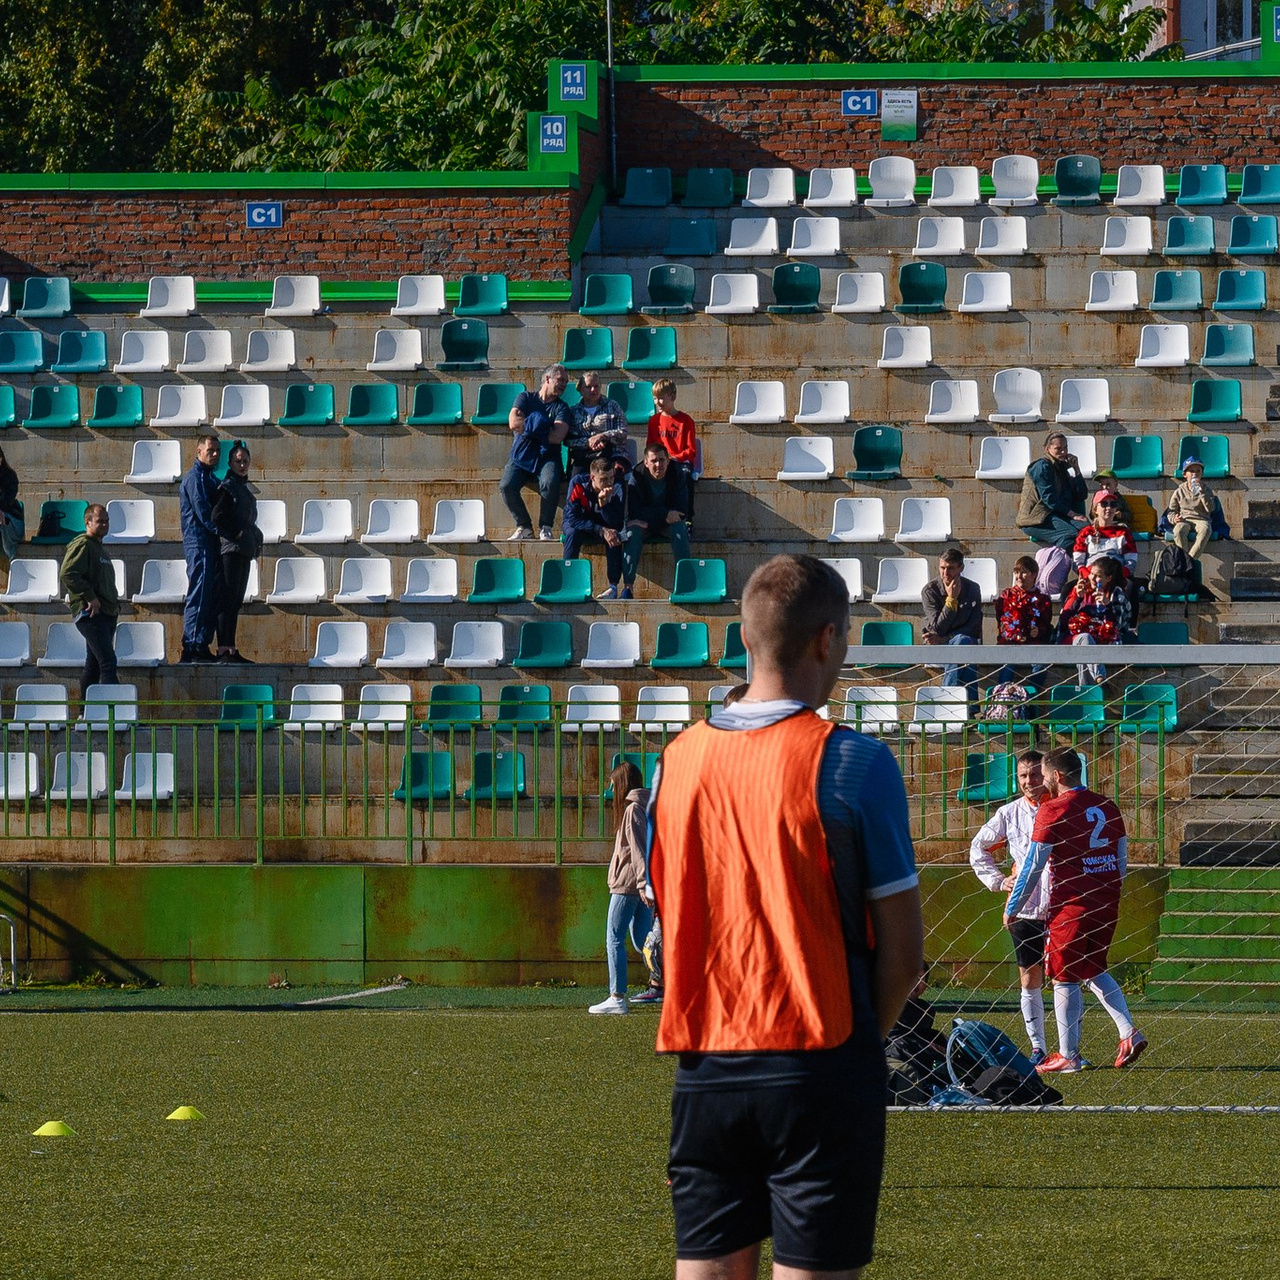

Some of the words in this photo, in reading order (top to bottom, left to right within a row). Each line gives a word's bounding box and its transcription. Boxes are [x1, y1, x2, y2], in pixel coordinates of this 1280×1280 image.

[563, 70, 581, 84] 11
[563, 86, 583, 95] РЯД
[543, 121, 563, 135] 10
[543, 138, 564, 148] РЯД
[1085, 806, 1109, 849] 2
